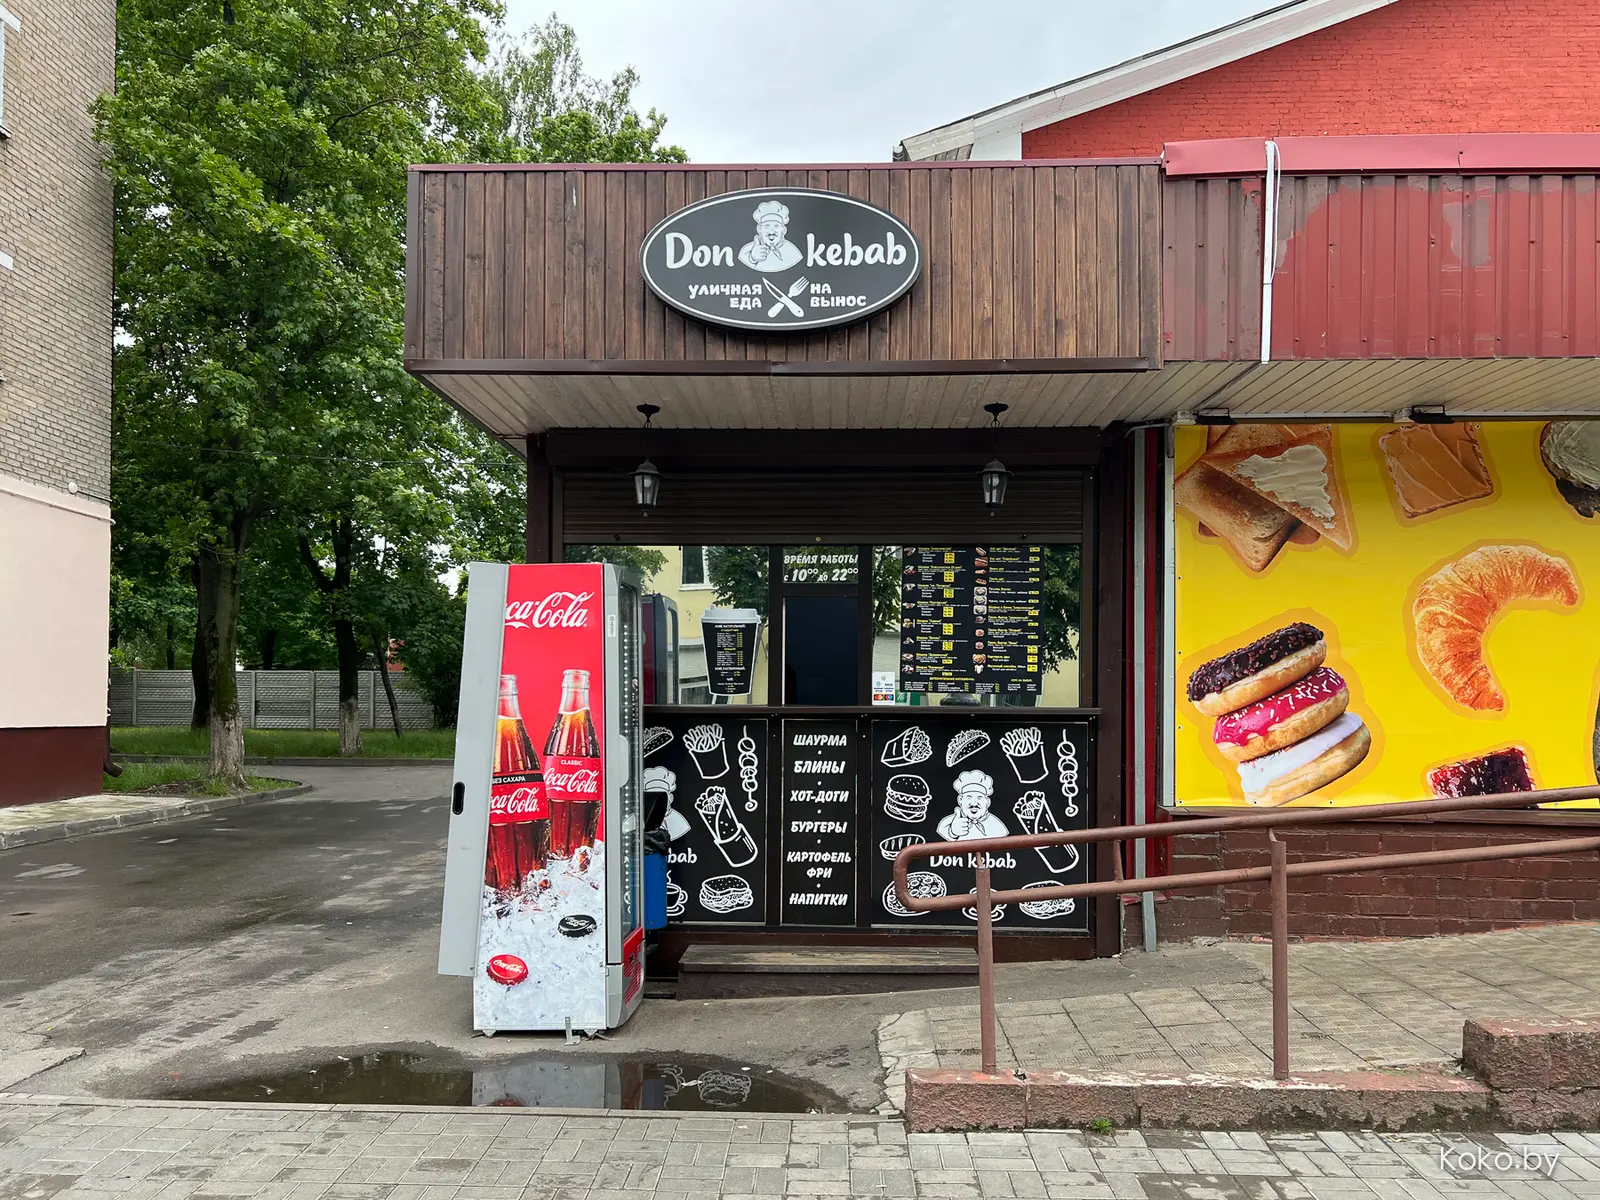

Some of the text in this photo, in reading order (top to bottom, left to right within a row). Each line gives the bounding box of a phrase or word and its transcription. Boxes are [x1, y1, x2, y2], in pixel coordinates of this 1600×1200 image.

[665, 232, 907, 269] Don kebab
[688, 283, 763, 300] УЛИЧНАЯ
[810, 283, 832, 295] НА
[730, 297, 762, 311] ЕДА
[810, 295, 867, 308] ВЫНОС
[783, 554, 859, 564] ВРЕМЯ РАБОТЫ
[505, 591, 595, 629] ca-Cola
[793, 734, 847, 746] ШАУРМА
[793, 760, 846, 774] БЛИНЫ
[503, 775, 526, 784] САХАРА
[543, 767, 599, 793] Coca-Cola
[490, 787, 540, 814] ca-Cola
[789, 790, 850, 803] ХОТ-ДОГИ
[790, 820, 848, 833] БУРГЕРЫ
[667, 847, 698, 864] bab
[786, 851, 852, 863] КАРТОФЕЛЬ
[806, 867, 833, 878] ФРИ
[789, 893, 848, 906] НАПИТКИ
